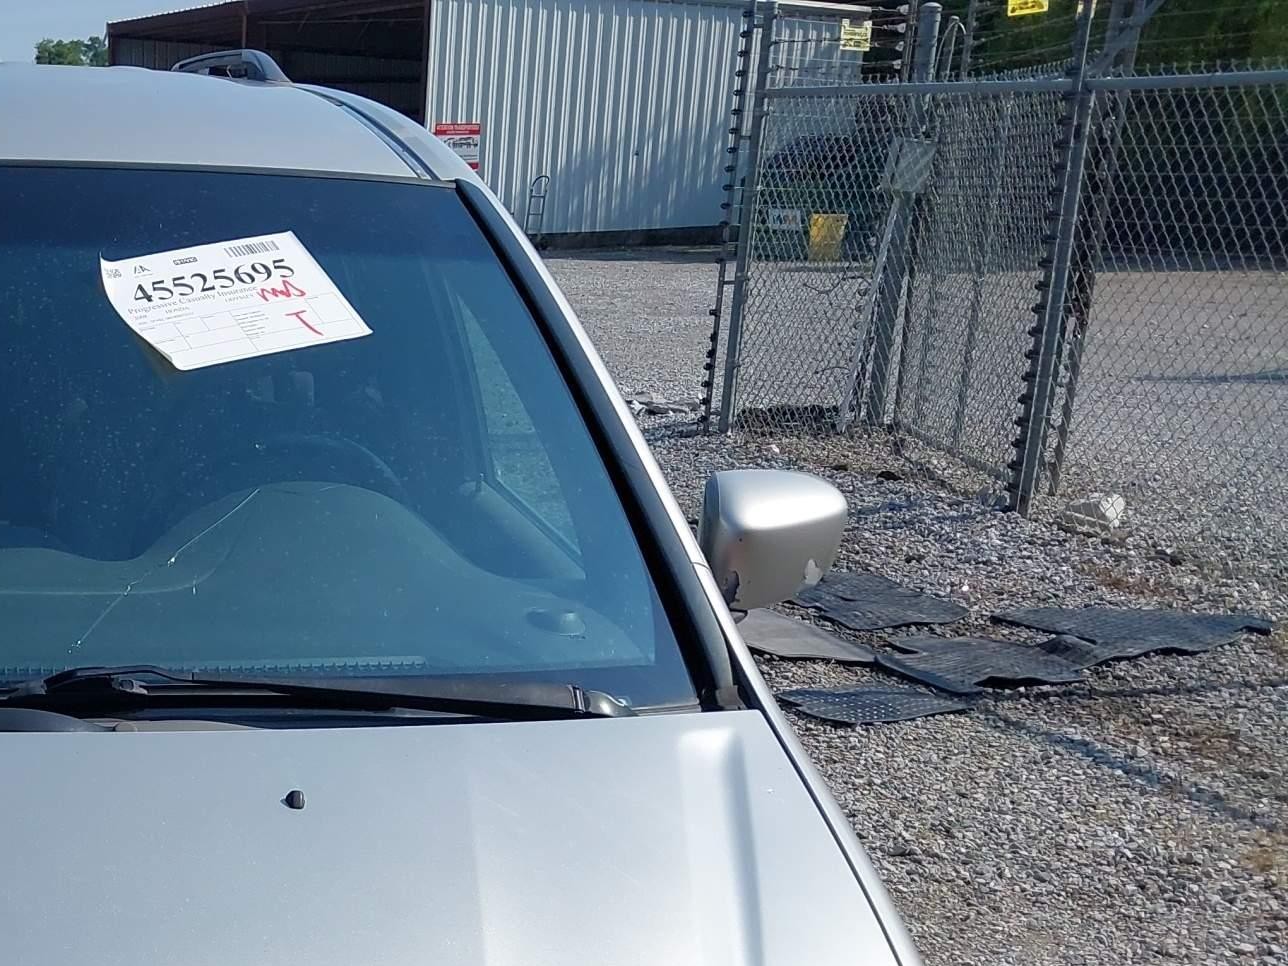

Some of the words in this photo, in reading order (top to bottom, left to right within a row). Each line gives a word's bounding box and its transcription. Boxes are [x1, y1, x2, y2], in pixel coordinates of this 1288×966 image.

[134, 258, 295, 303] 45525695
[128, 300, 178, 315] Progressive
[178, 293, 216, 305] Casualty
[285, 309, 324, 337] T
